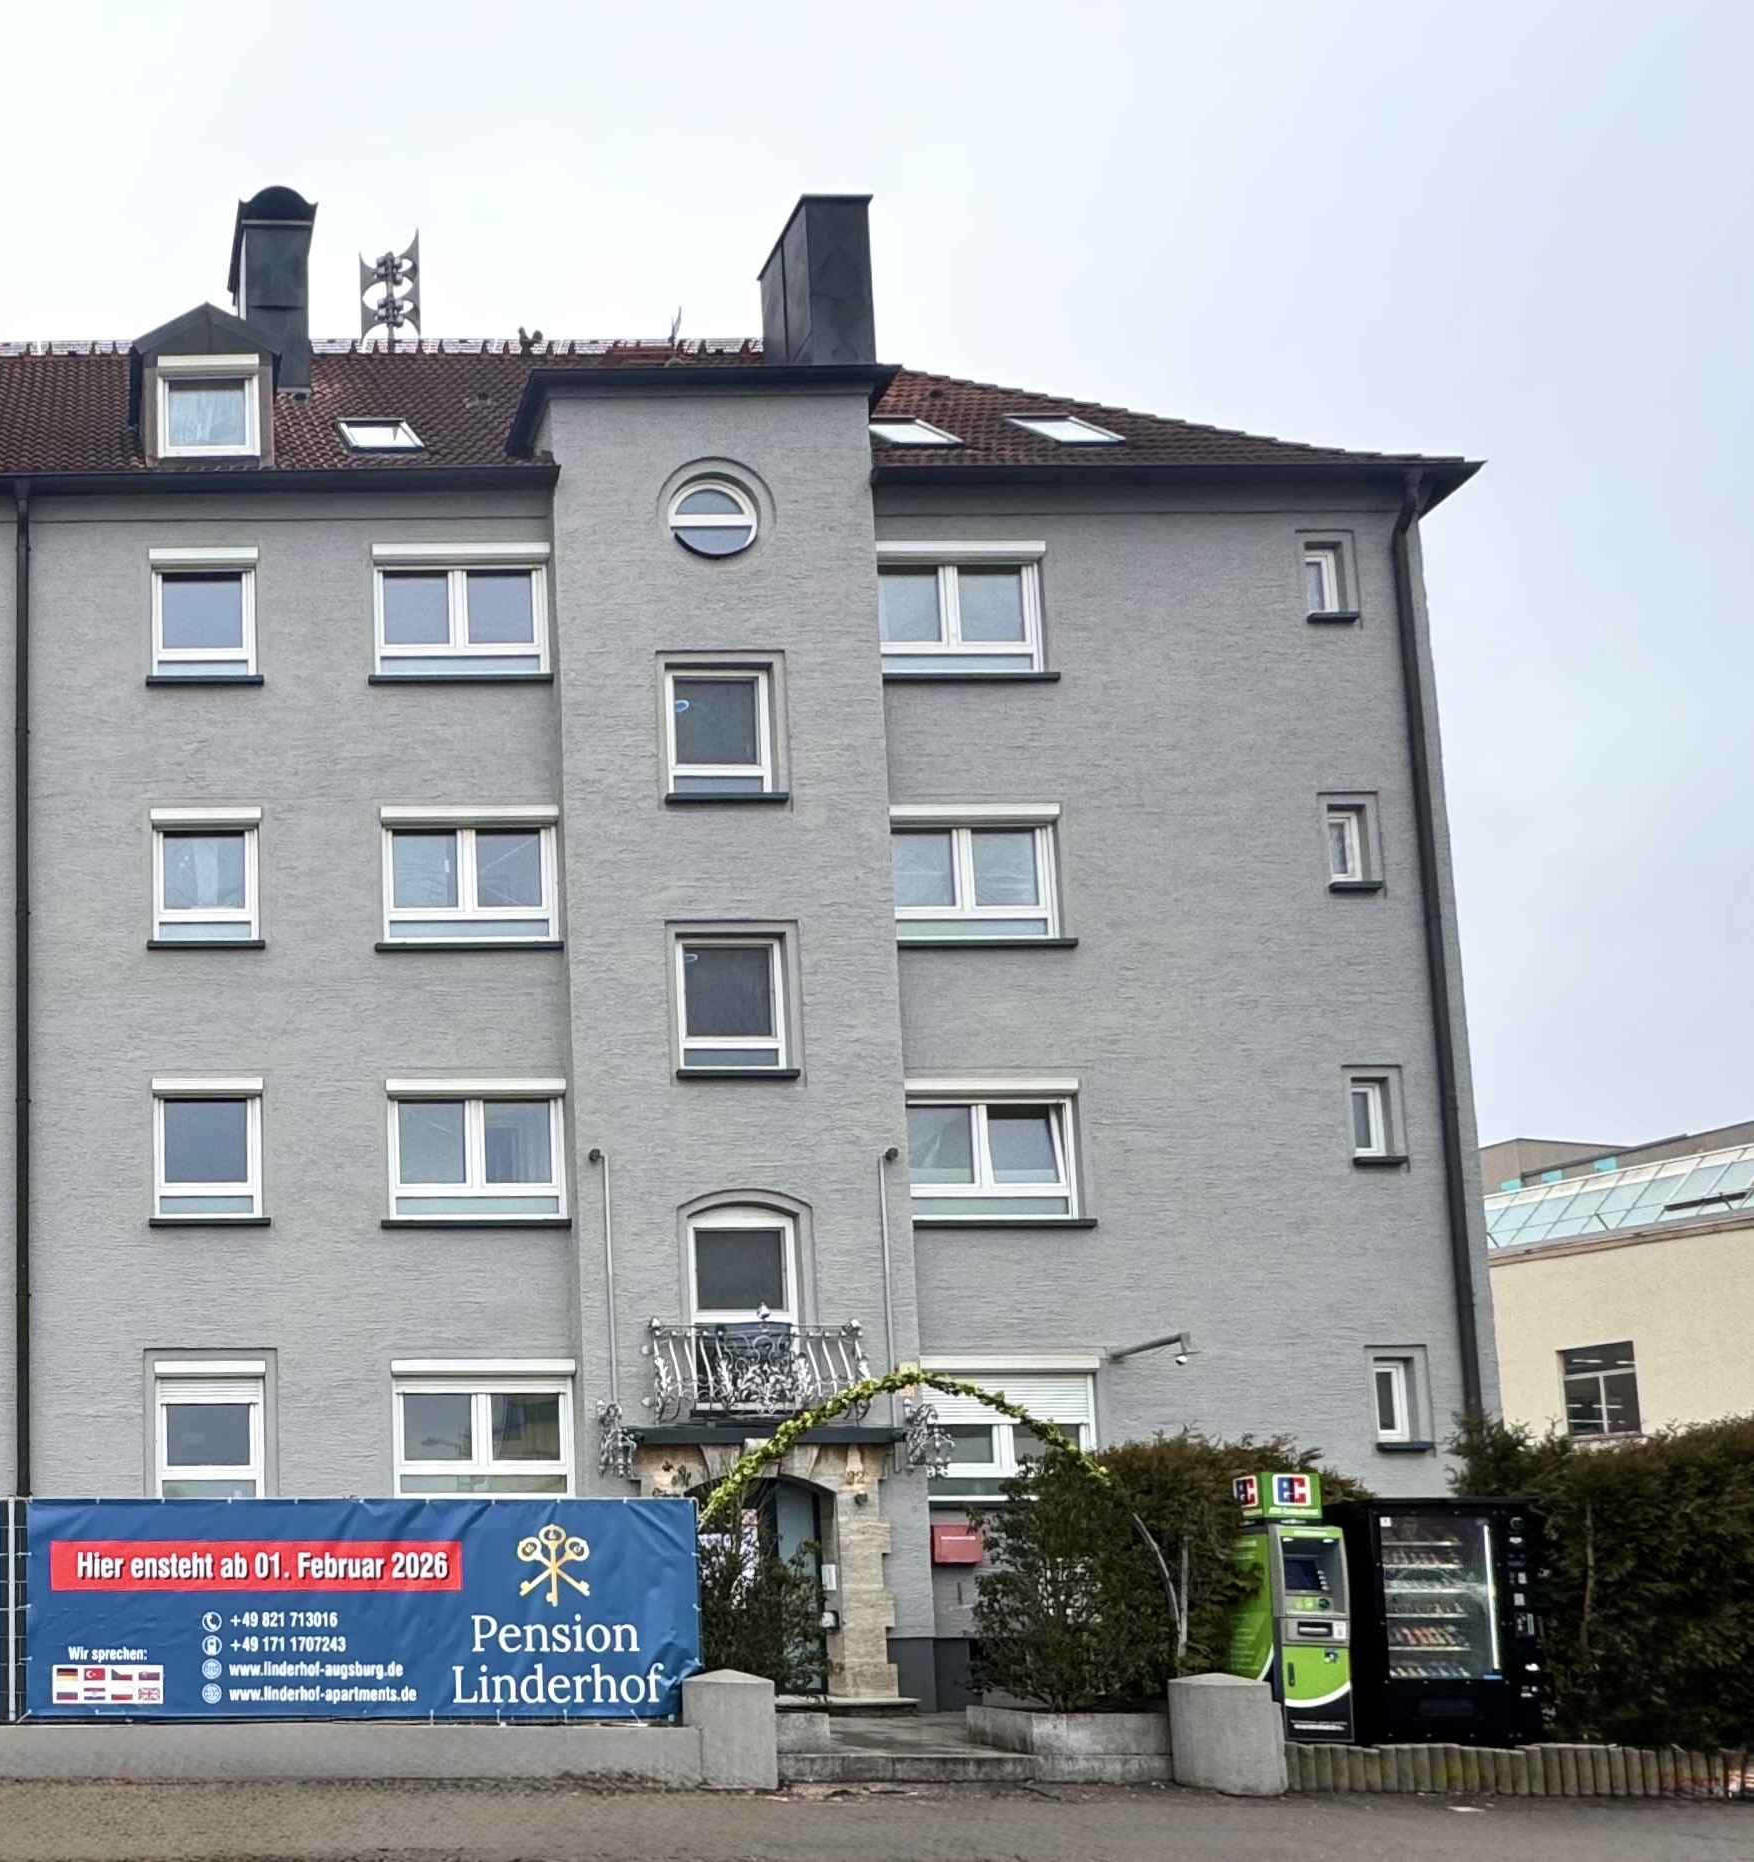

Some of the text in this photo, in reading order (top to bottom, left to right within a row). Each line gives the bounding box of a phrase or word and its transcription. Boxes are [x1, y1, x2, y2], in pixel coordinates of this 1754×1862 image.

[77, 1551, 448, 1579] Hier ensteht ab 01. Februar 2026
[230, 1611, 338, 1628] +49 821 713016
[471, 1613, 641, 1653] Pension
[230, 1636, 347, 1653] +49 171 1707243
[68, 1646, 148, 1664] Wir sprechen:
[228, 1660, 404, 1680] www.linderhof-augsburg.de
[452, 1662, 664, 1704] Linderhof
[228, 1685, 417, 1705] www.linderhof-apartments.de
